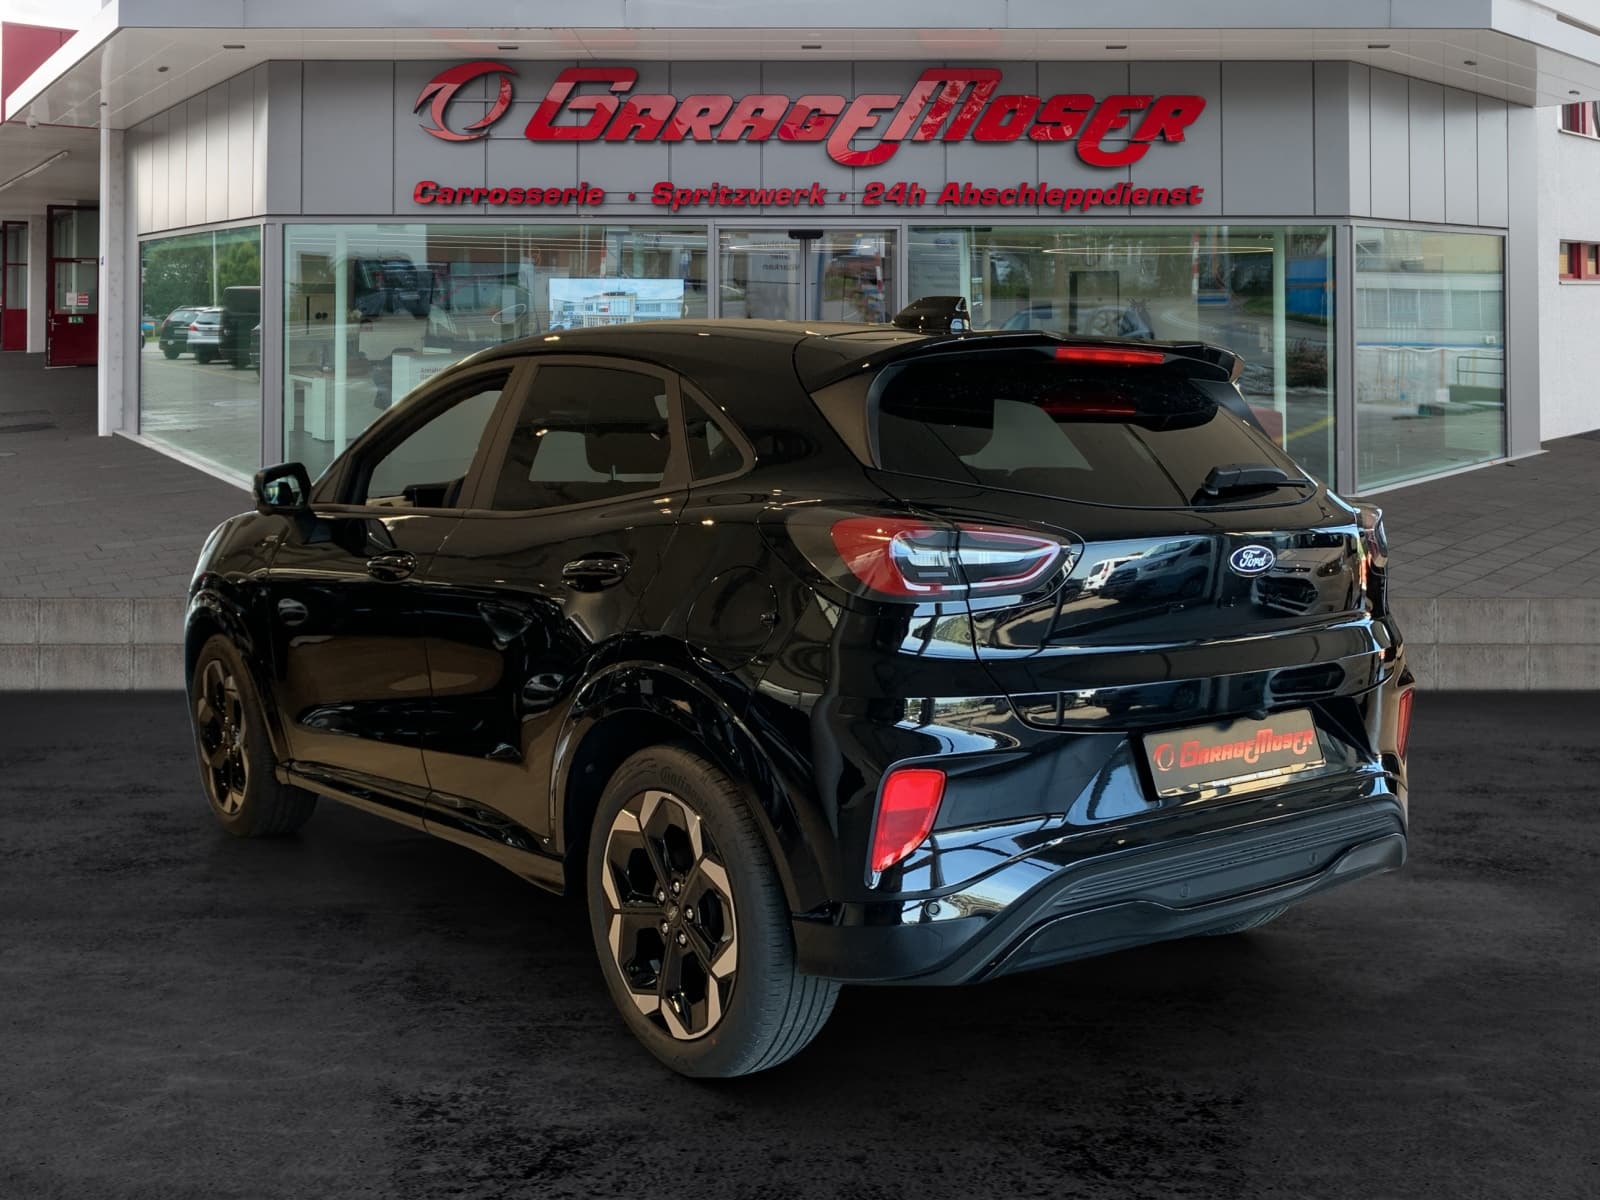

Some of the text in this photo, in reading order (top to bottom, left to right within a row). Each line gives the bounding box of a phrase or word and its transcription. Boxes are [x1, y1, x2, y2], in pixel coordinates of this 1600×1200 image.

[413, 181, 1204, 212] Carrosserie Spritzwerk 24h Abschleppdienst
[1240, 549, 1267, 568] Ford
